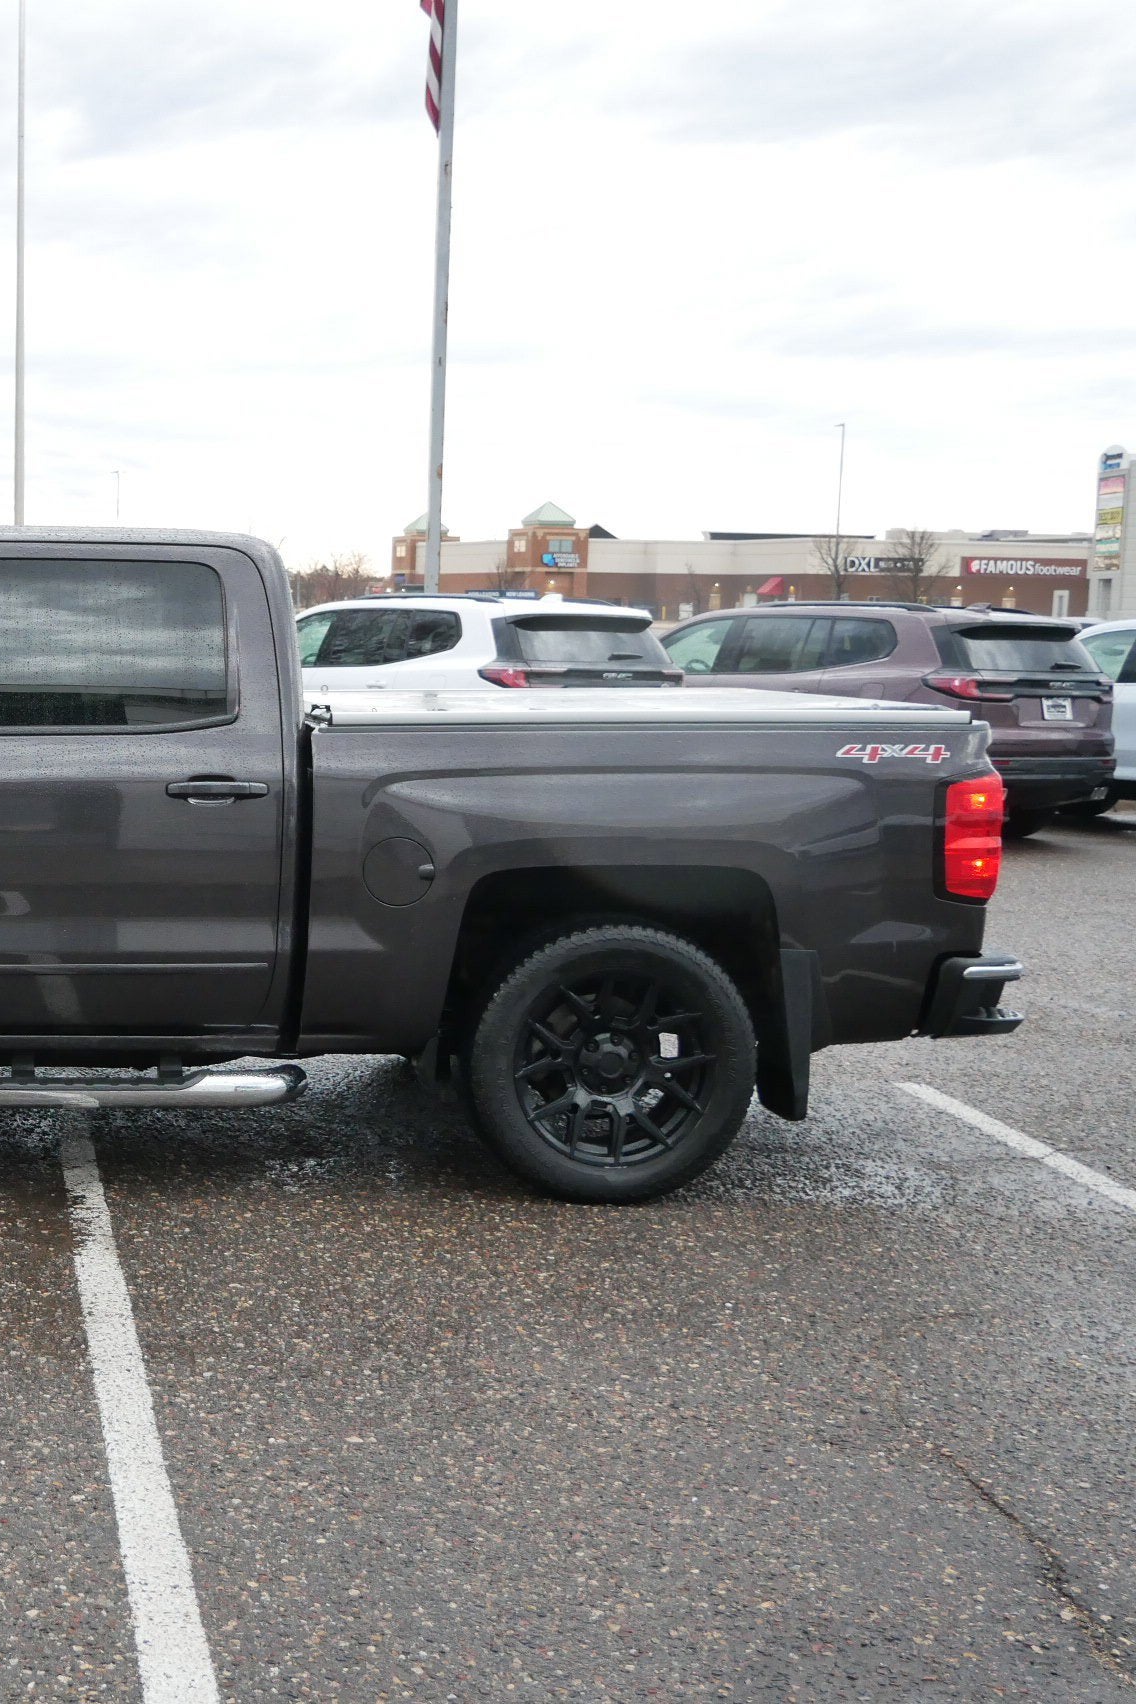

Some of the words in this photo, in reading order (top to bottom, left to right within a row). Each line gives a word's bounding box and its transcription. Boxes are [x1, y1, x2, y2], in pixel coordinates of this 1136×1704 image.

[846, 557, 879, 572] DXL
[980, 560, 1035, 575] FAMOUS
[1035, 563, 1082, 575] footwear
